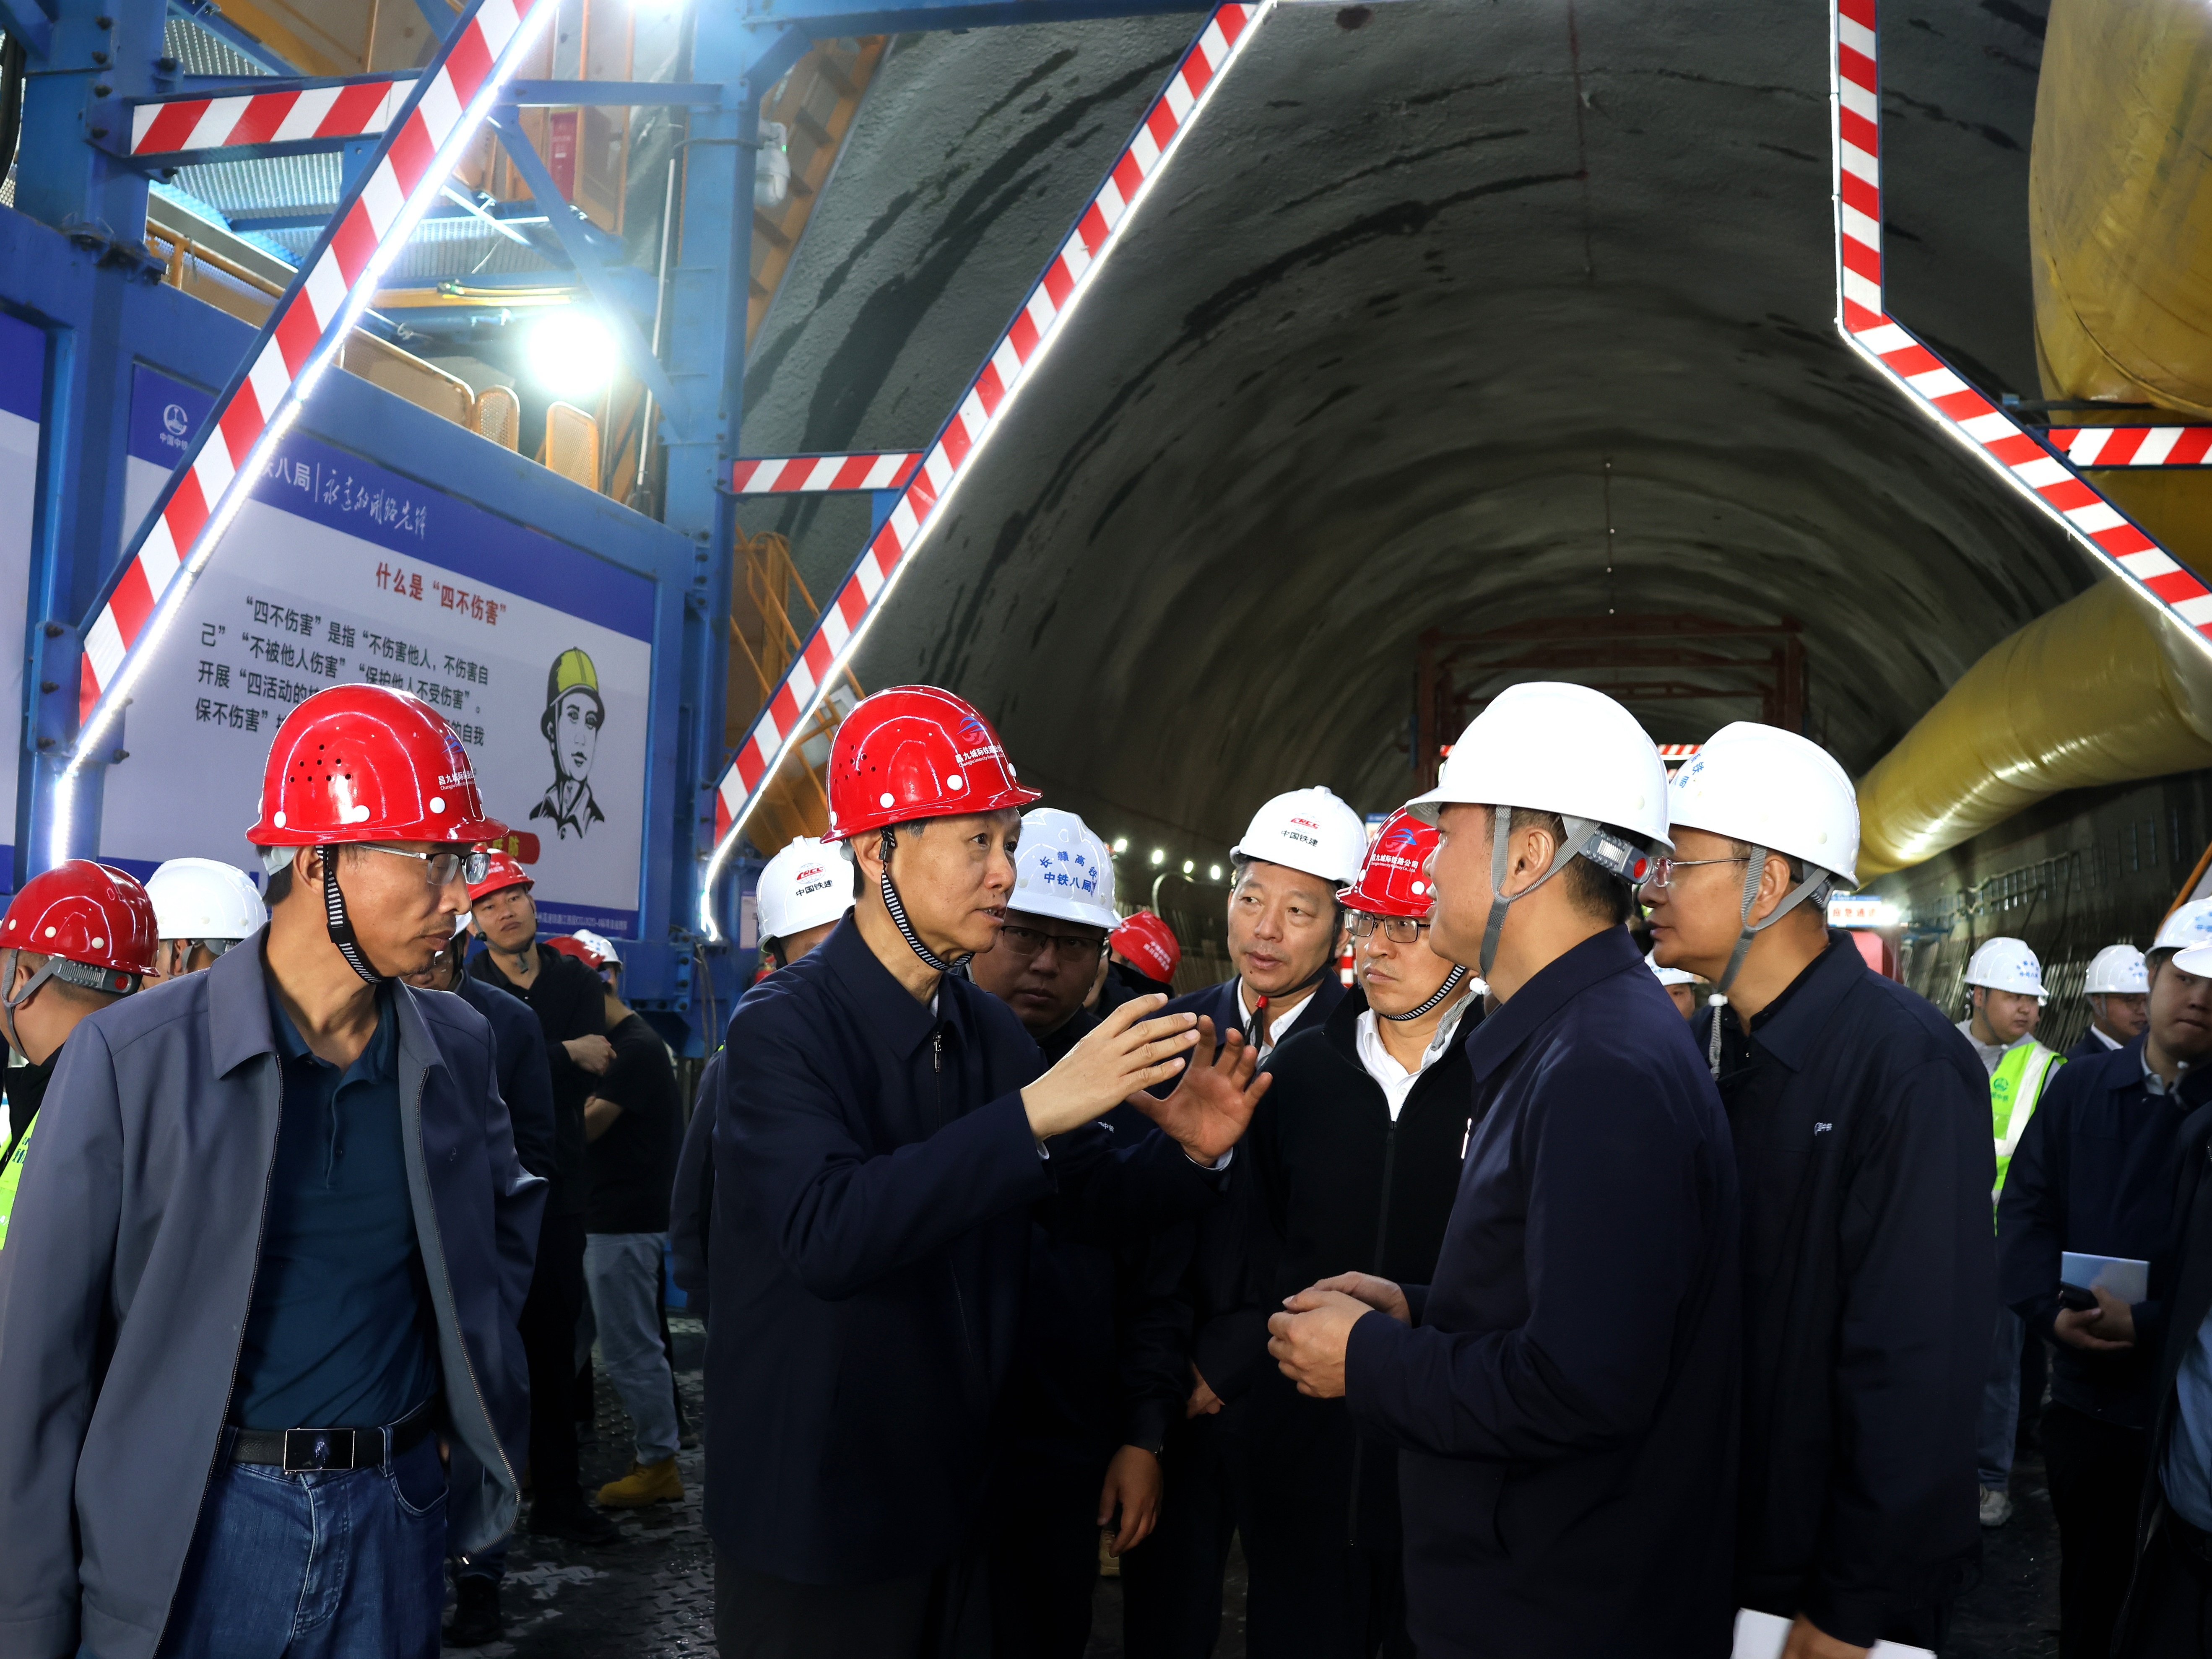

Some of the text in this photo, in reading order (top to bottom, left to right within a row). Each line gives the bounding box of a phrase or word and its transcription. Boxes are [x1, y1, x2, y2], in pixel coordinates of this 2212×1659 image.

[376, 562, 506, 625] 什么是“四不伤害”
[195, 697, 286, 732] 保不伤害”
[1281, 830, 1318, 847] 中国铁建
[797, 867, 824, 880] CRCC
[1044, 872, 1091, 892] 中铁八局
[796, 880, 833, 896] 中国铁建
